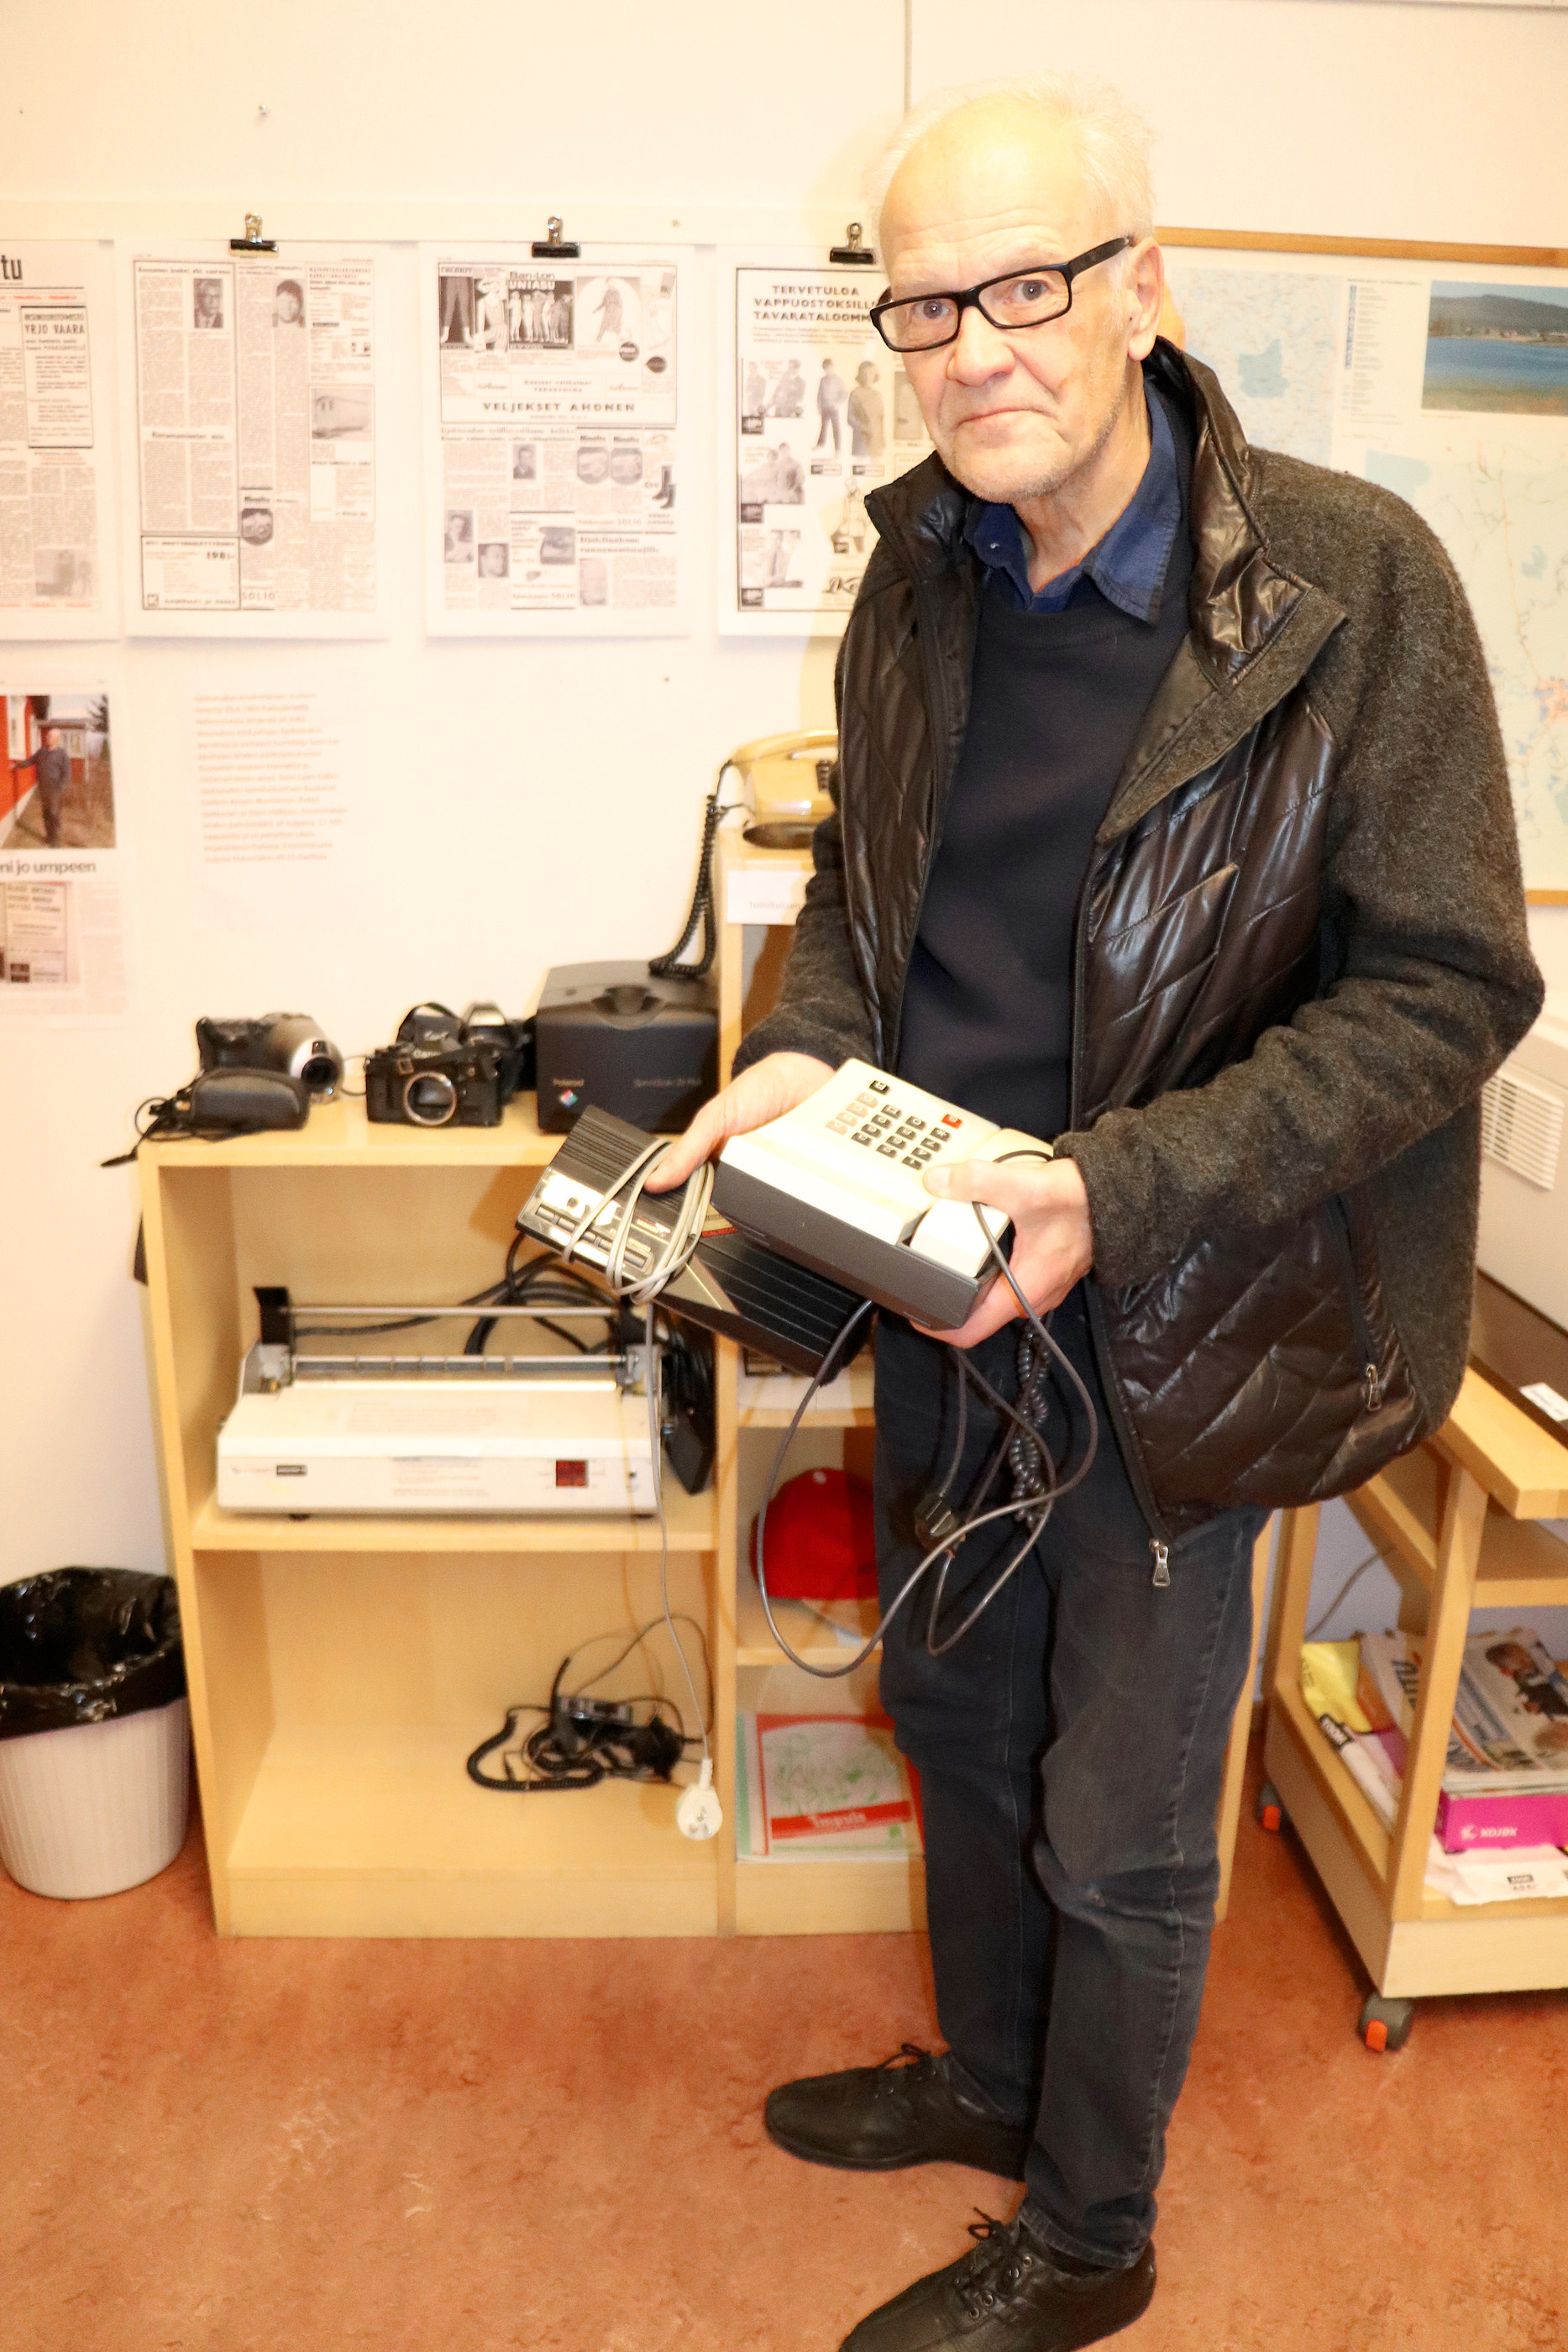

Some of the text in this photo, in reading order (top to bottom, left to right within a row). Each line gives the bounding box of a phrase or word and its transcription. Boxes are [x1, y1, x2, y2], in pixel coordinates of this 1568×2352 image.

[773, 285, 860, 296] TERVETULOA
[754, 311, 871, 322] TAVARATALOOMM
[54, 324, 85, 334] VAARA
[483, 402, 636, 413] VELJEKSET AHONEN
[17, 860, 30, 875] jo
[34, 862, 97, 875] umpeen
[1481, 1827, 1518, 1838] xerox
